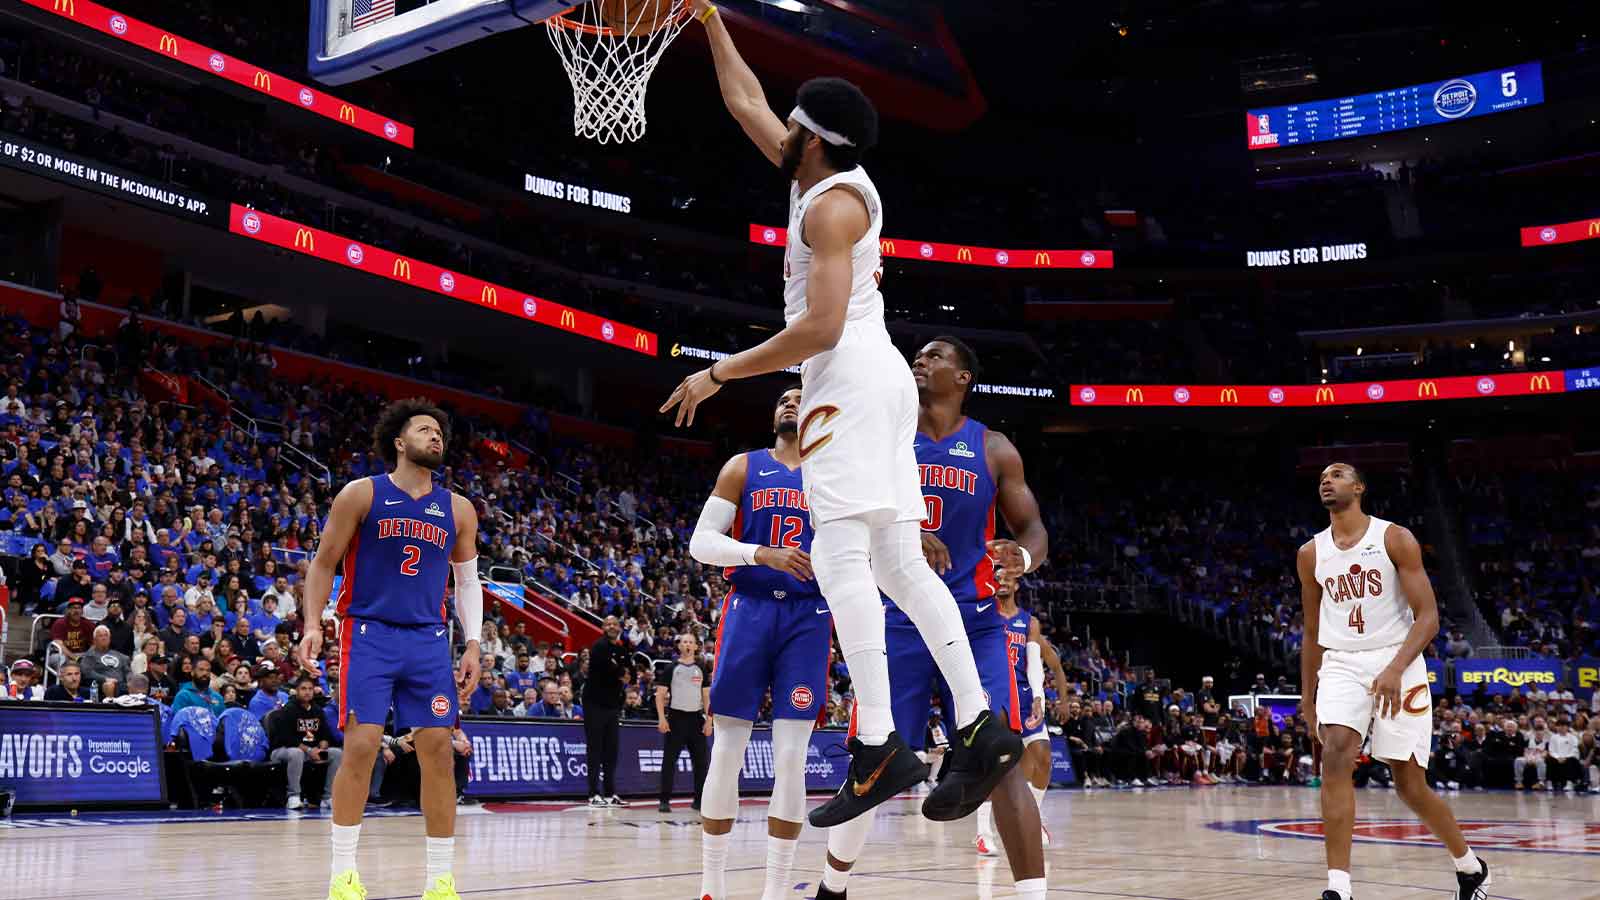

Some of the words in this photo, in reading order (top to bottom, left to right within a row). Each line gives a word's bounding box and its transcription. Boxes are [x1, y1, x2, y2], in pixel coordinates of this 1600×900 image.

[1441, 90, 1468, 101] DETROIT
[1501, 71, 1518, 97] 5
[4, 142, 19, 157] OF
[20, 146, 34, 163] $2
[37, 153, 52, 168] OR
[54, 157, 84, 178] MORE
[86, 168, 98, 182] IN
[100, 171, 119, 188] THE
[121, 178, 185, 208] MCDONALD'S
[186, 199, 209, 215] APP.
[524, 173, 564, 199] DUNKS
[567, 184, 589, 205] FOR
[592, 189, 631, 214] DUNKS
[1246, 249, 1290, 267] DUNKS
[1293, 247, 1319, 264] FOR
[1321, 242, 1367, 262] DUNKS
[670, 342, 681, 357] 6
[681, 345, 710, 359] PISTONS
[977, 384, 991, 393] THE
[992, 385, 1037, 397] MCDONALD'S
[1038, 388, 1055, 398] APP.
[918, 463, 978, 496] TROIT
[751, 487, 811, 513] DETRO
[377, 517, 448, 550] DETROIT
[769, 514, 804, 549] 12
[400, 545, 421, 576] 2
[1324, 568, 1383, 604] CAVS
[1348, 604, 1366, 634] 4
[88, 739, 121, 753] Presented
[122, 739, 131, 755] by
[472, 736, 563, 782] PLAYOFFS
[638, 750, 693, 772] ESN
[743, 740, 775, 778] LAYO
[89, 754, 151, 779] Google
